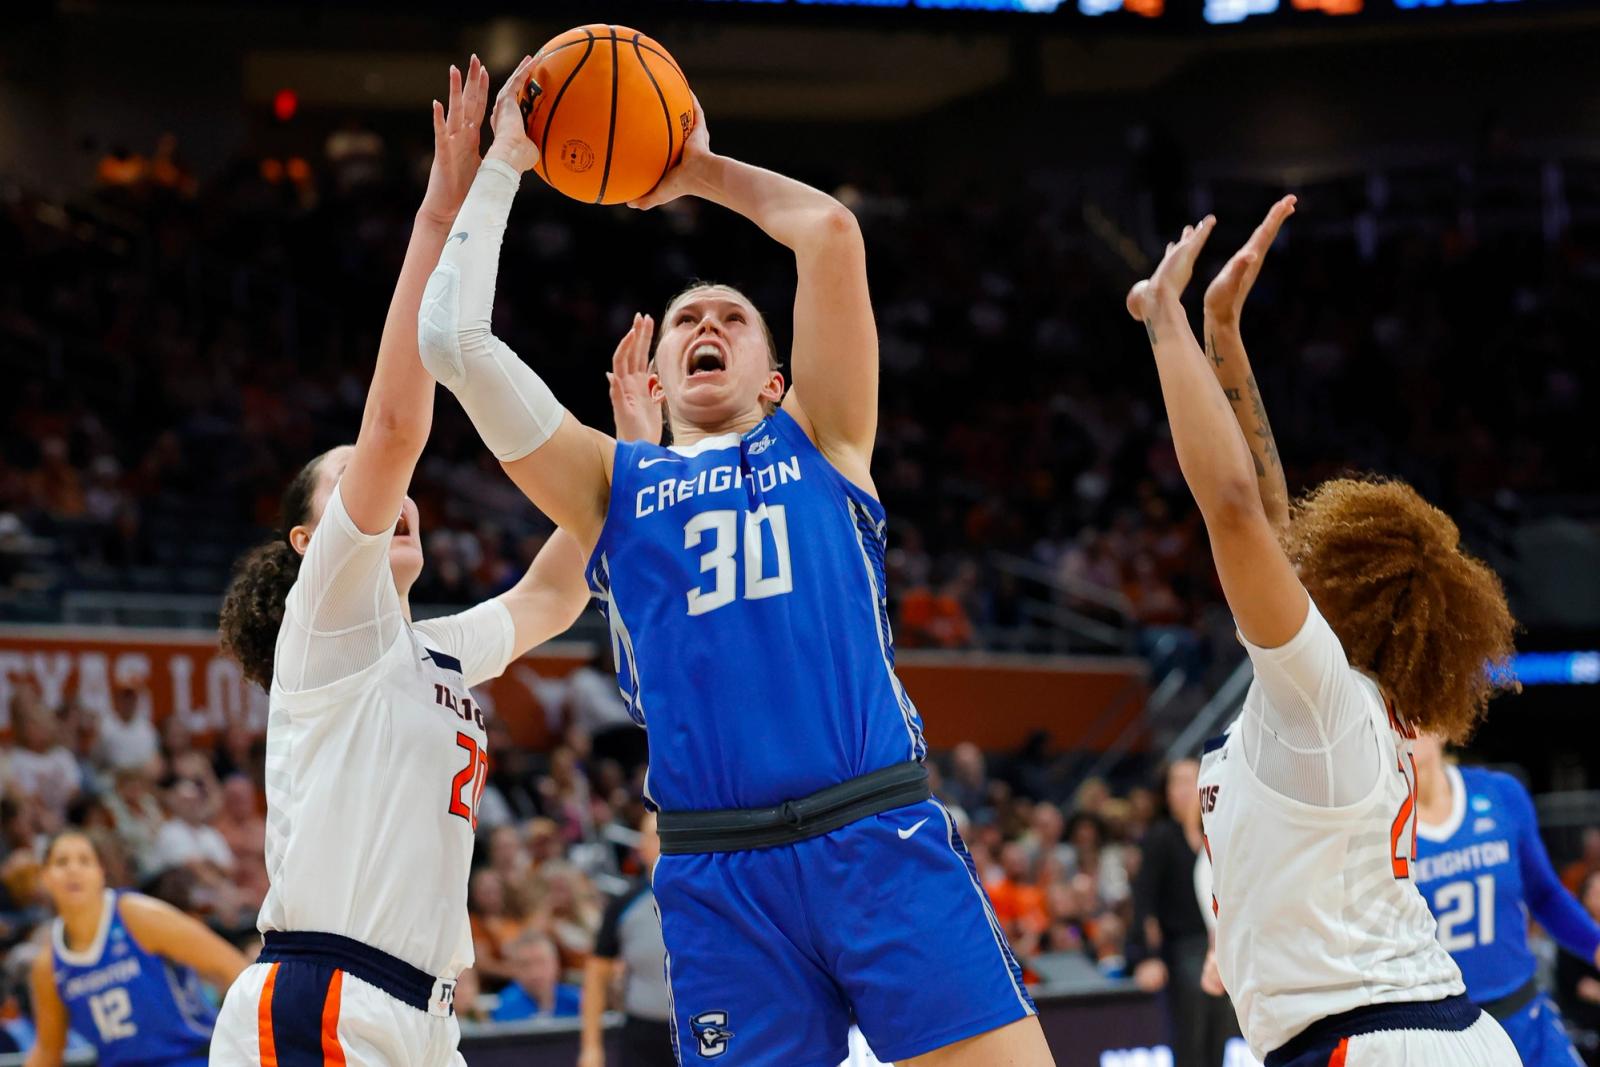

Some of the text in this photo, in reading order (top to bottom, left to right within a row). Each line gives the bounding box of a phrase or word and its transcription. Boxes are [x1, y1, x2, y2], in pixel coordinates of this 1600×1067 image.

[683, 503, 793, 616] 30
[448, 730, 488, 833] 20
[1433, 875, 1495, 950] 21
[90, 986, 137, 1043] 12
